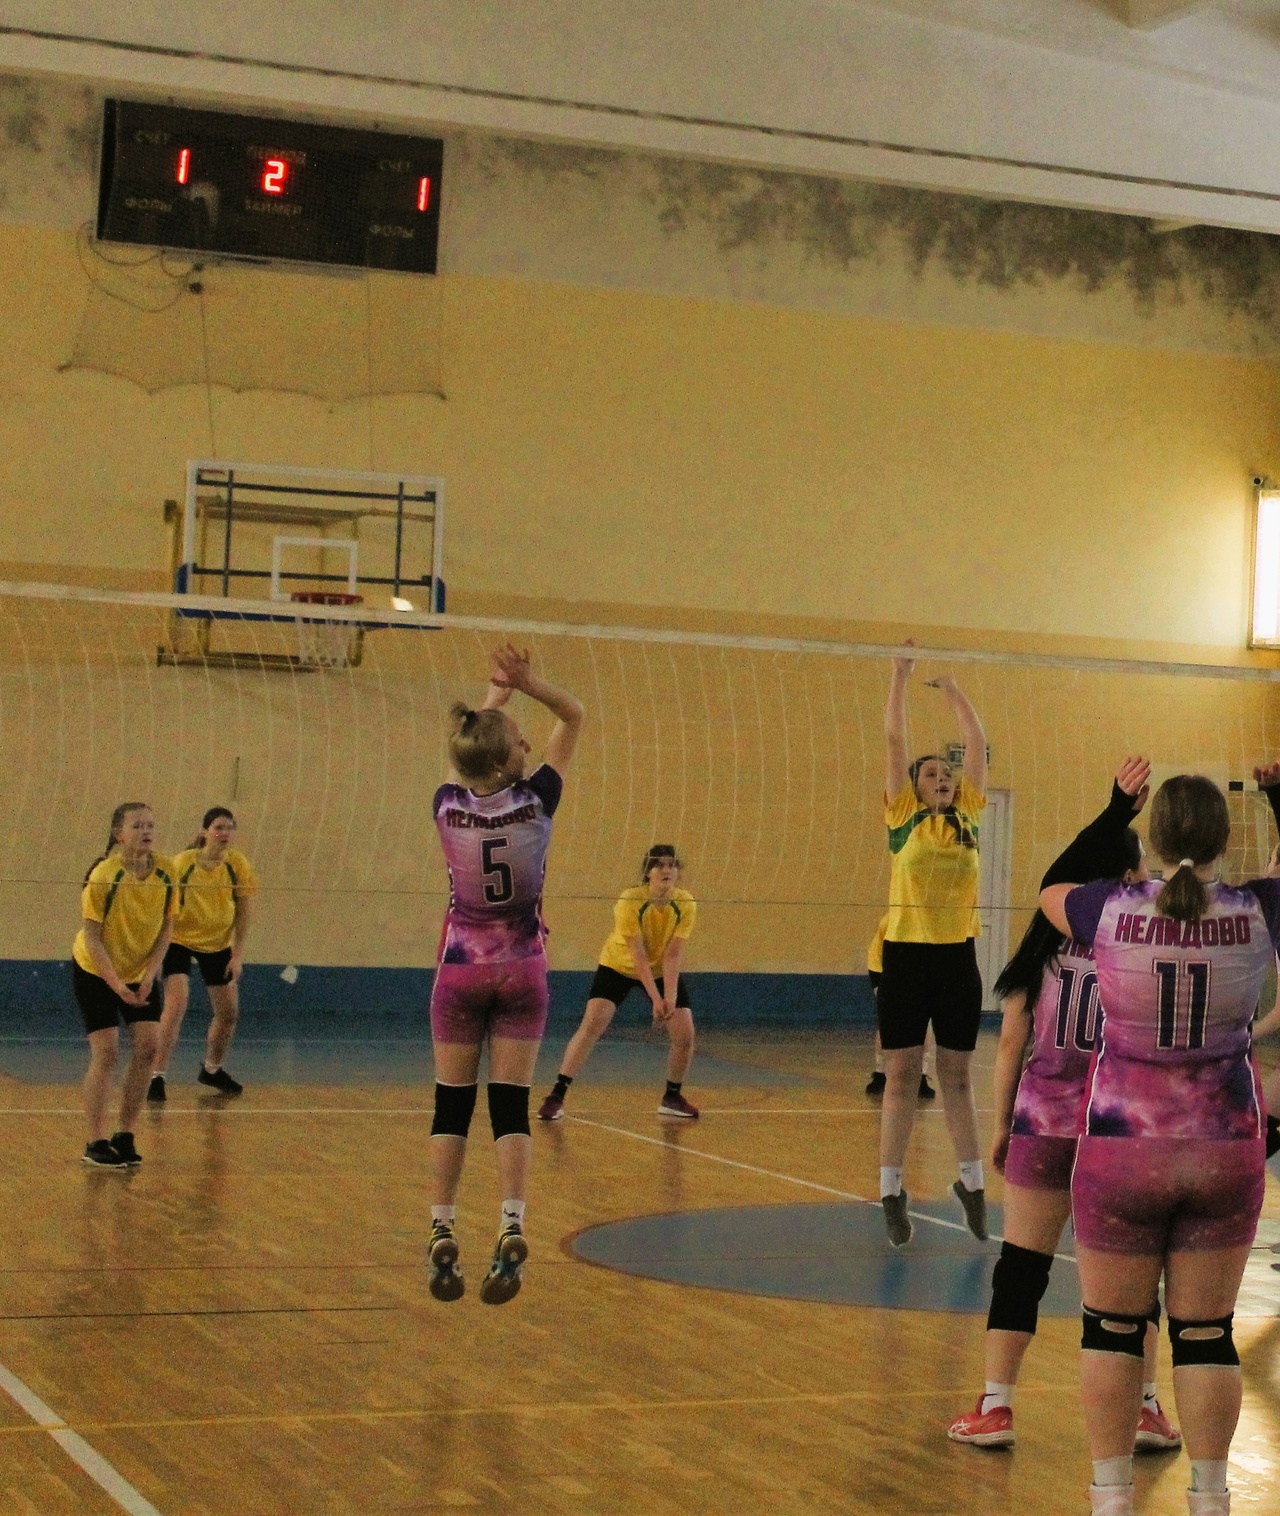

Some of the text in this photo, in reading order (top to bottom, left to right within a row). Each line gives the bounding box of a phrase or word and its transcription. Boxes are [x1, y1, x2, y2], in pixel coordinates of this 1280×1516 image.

[176, 148, 191, 185] 1
[261, 157, 290, 193] 2
[416, 177, 431, 212] 1
[481, 836, 515, 904] 5
[1114, 913, 1251, 949] НЕЛИДОВО
[1055, 966, 1100, 1053] 10
[1153, 957, 1212, 1051] 11
